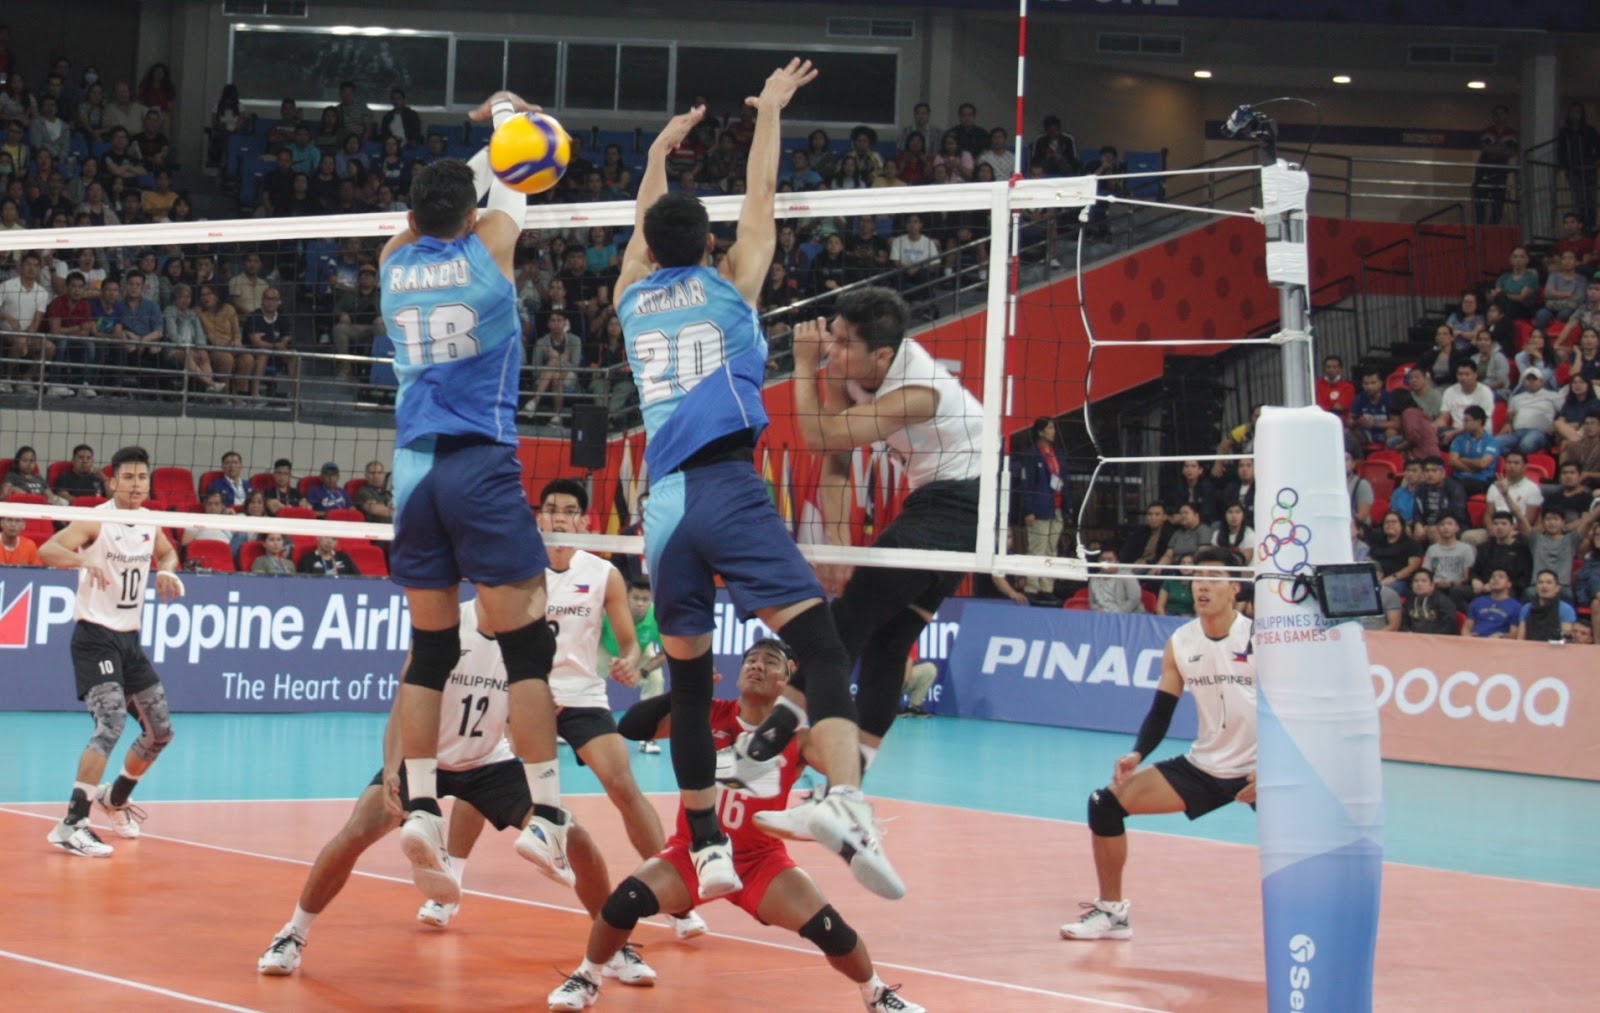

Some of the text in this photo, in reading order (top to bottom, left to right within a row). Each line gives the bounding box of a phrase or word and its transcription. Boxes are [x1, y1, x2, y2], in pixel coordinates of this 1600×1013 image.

[389, 257, 470, 293] RANDU
[394, 303, 480, 364] 18
[634, 321, 724, 403] 20
[106, 551, 153, 563] PHILIPPINE
[120, 568, 141, 601] 10
[312, 594, 411, 651] Airli
[548, 605, 591, 617] PPINES
[1284, 629, 1327, 643] GAMES
[98, 660, 114, 675] 10
[981, 636, 1166, 689] PINAC
[222, 673, 400, 700] The Heart of th
[458, 694, 489, 738] 12
[1290, 966, 1310, 1013] Se
